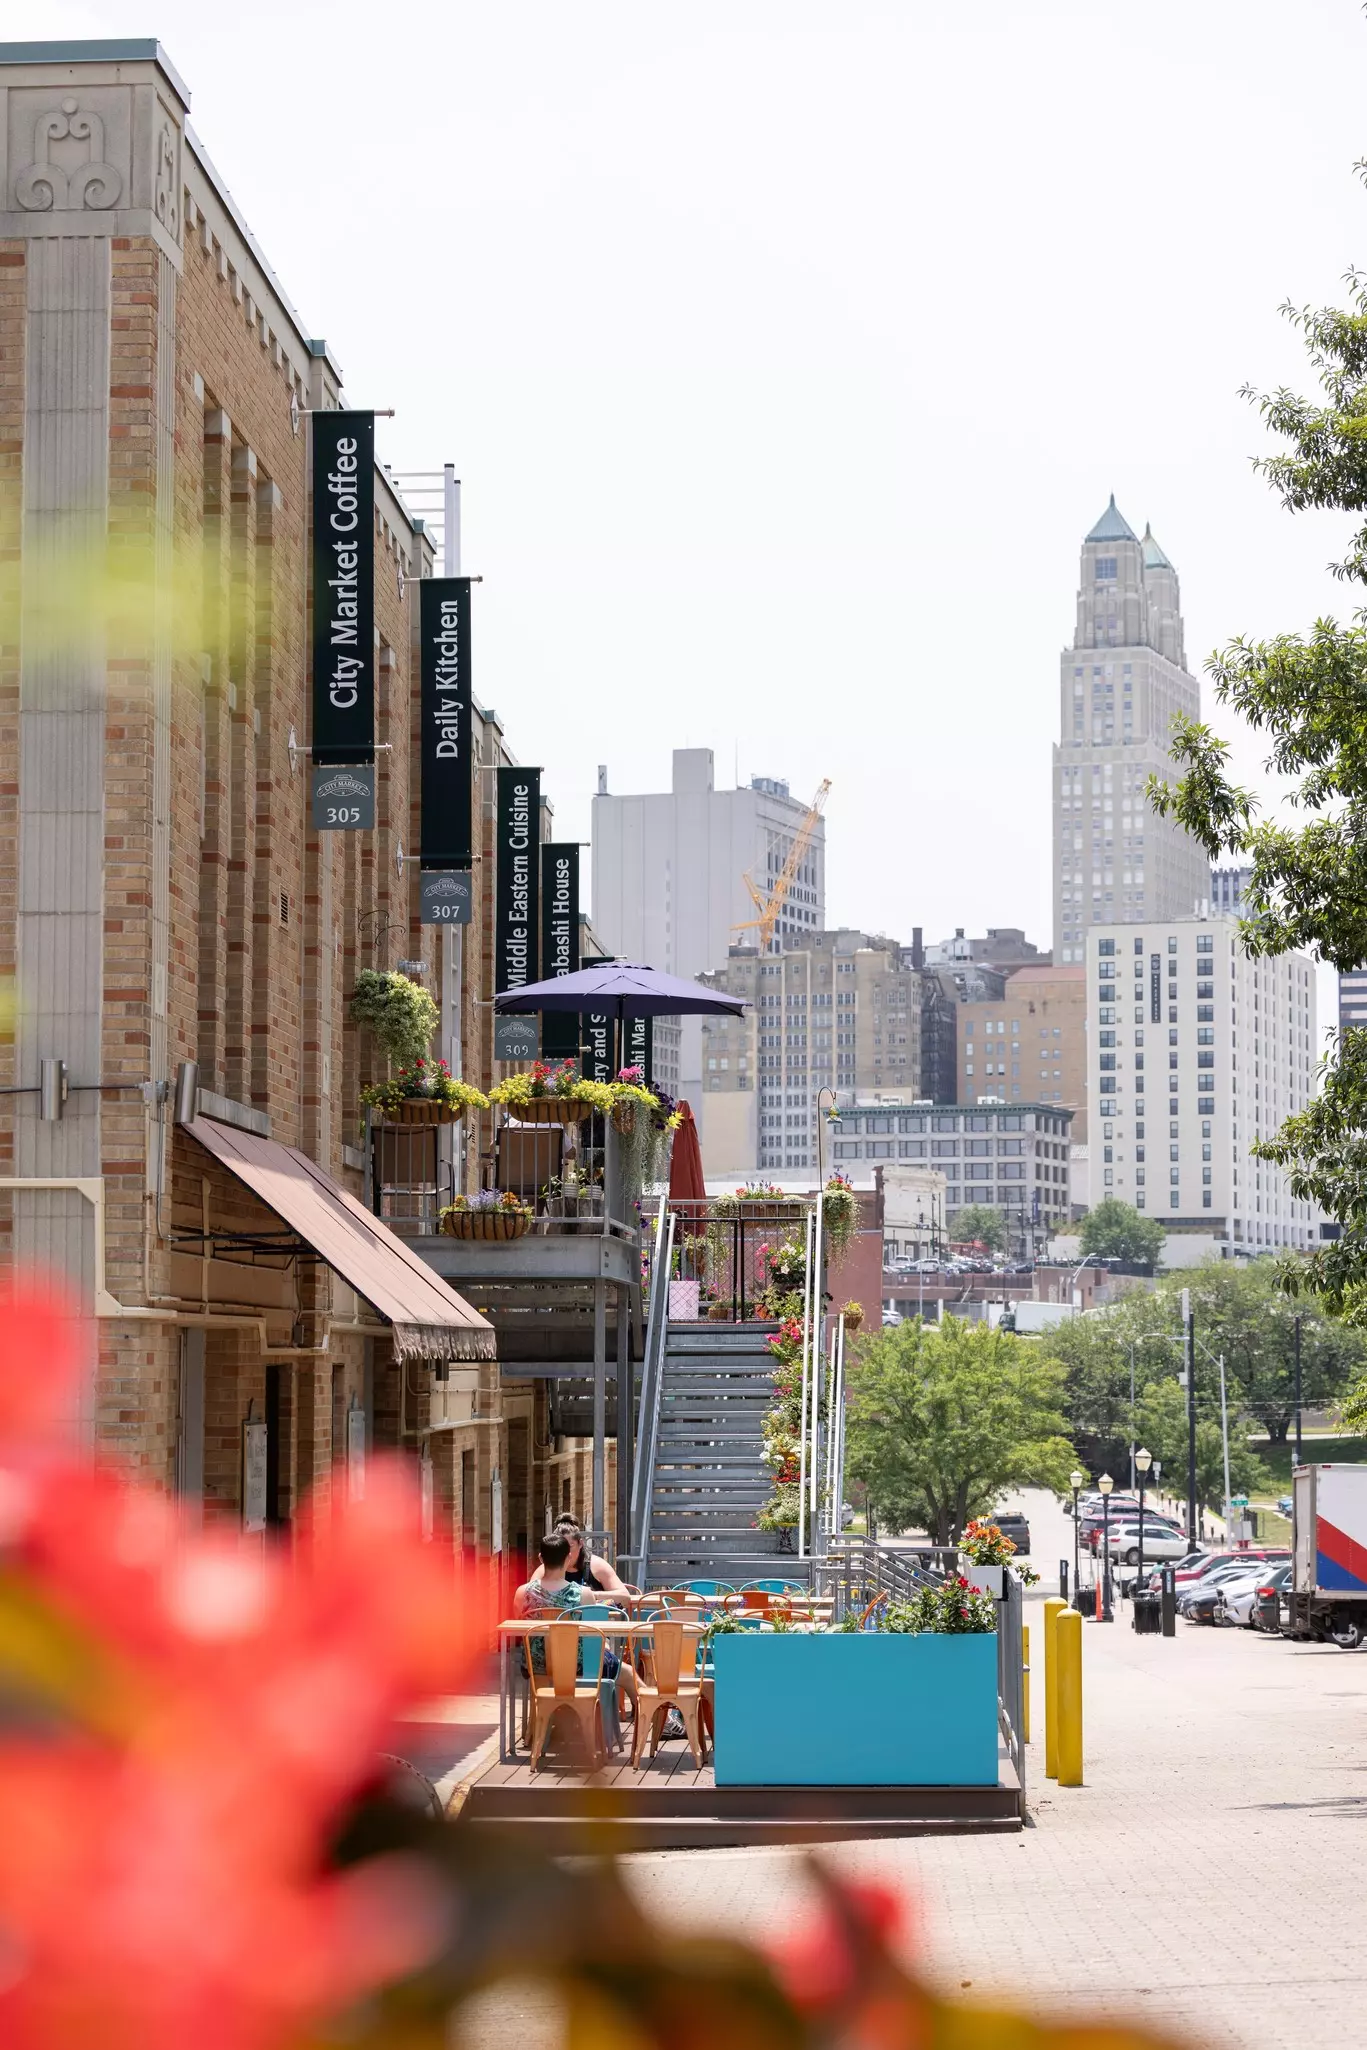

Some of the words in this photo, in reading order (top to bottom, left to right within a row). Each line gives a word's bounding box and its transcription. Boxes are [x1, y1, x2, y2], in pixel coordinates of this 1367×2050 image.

[328, 437, 359, 532] Coffee
[328, 540, 358, 646] Market
[433, 599, 459, 691] Kitchen
[330, 654, 364, 709] City
[433, 697, 464, 759] Daily
[327, 807, 361, 823] 305
[508, 784, 529, 850] Cuisine
[432, 905, 460, 919] 307
[509, 855, 529, 922] Eastern
[552, 858, 570, 914] House
[506, 927, 528, 990] Middle
[551, 919, 570, 978] abashi
[589, 1028, 607, 1058] and
[590, 1013, 607, 1024] S
[631, 1017, 646, 1046] Mar
[505, 1044, 529, 1056] 309
[594, 1061, 609, 1085] ery
